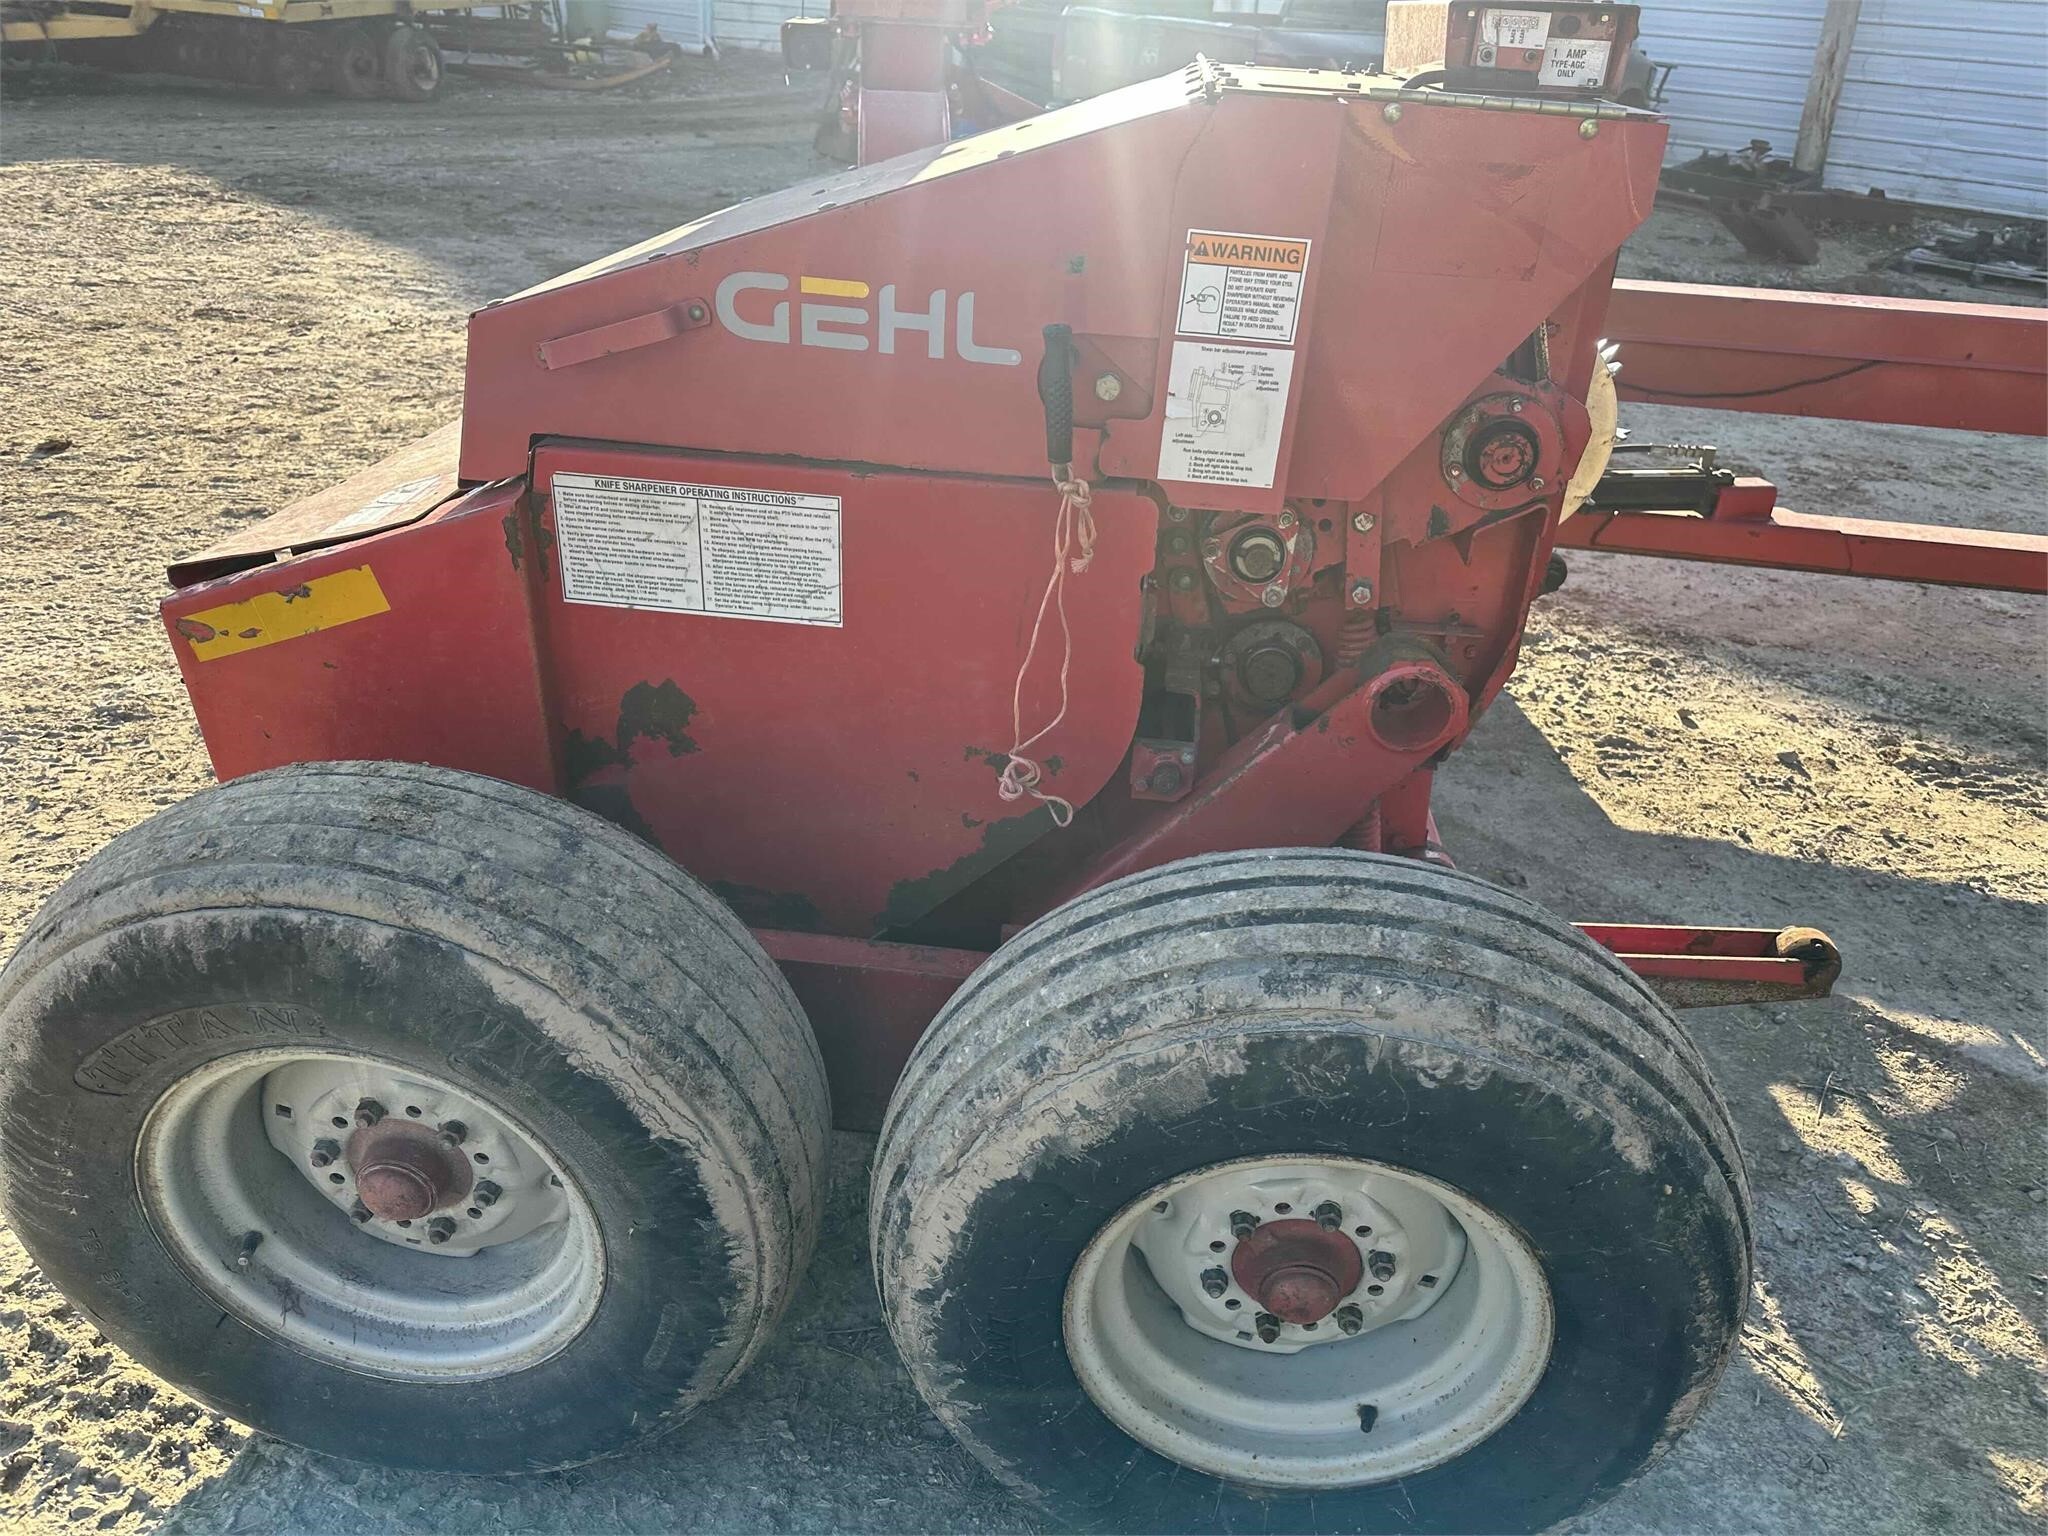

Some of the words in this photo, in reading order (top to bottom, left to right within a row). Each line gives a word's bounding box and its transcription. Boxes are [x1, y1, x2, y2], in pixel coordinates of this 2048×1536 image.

[1550, 59, 1586, 70] TYPE-AGC
[1566, 48, 1587, 59] AMP
[1557, 69, 1576, 78] ONLY
[1212, 241, 1300, 265] WARNING
[715, 271, 1022, 366] GEHL
[594, 479, 621, 490] KNIFE
[623, 482, 677, 495] SHARPENER
[680, 486, 730, 500] OPERATING
[732, 491, 797, 505] INSTRUCTIONS
[84, 1006, 300, 1085] TITAN
